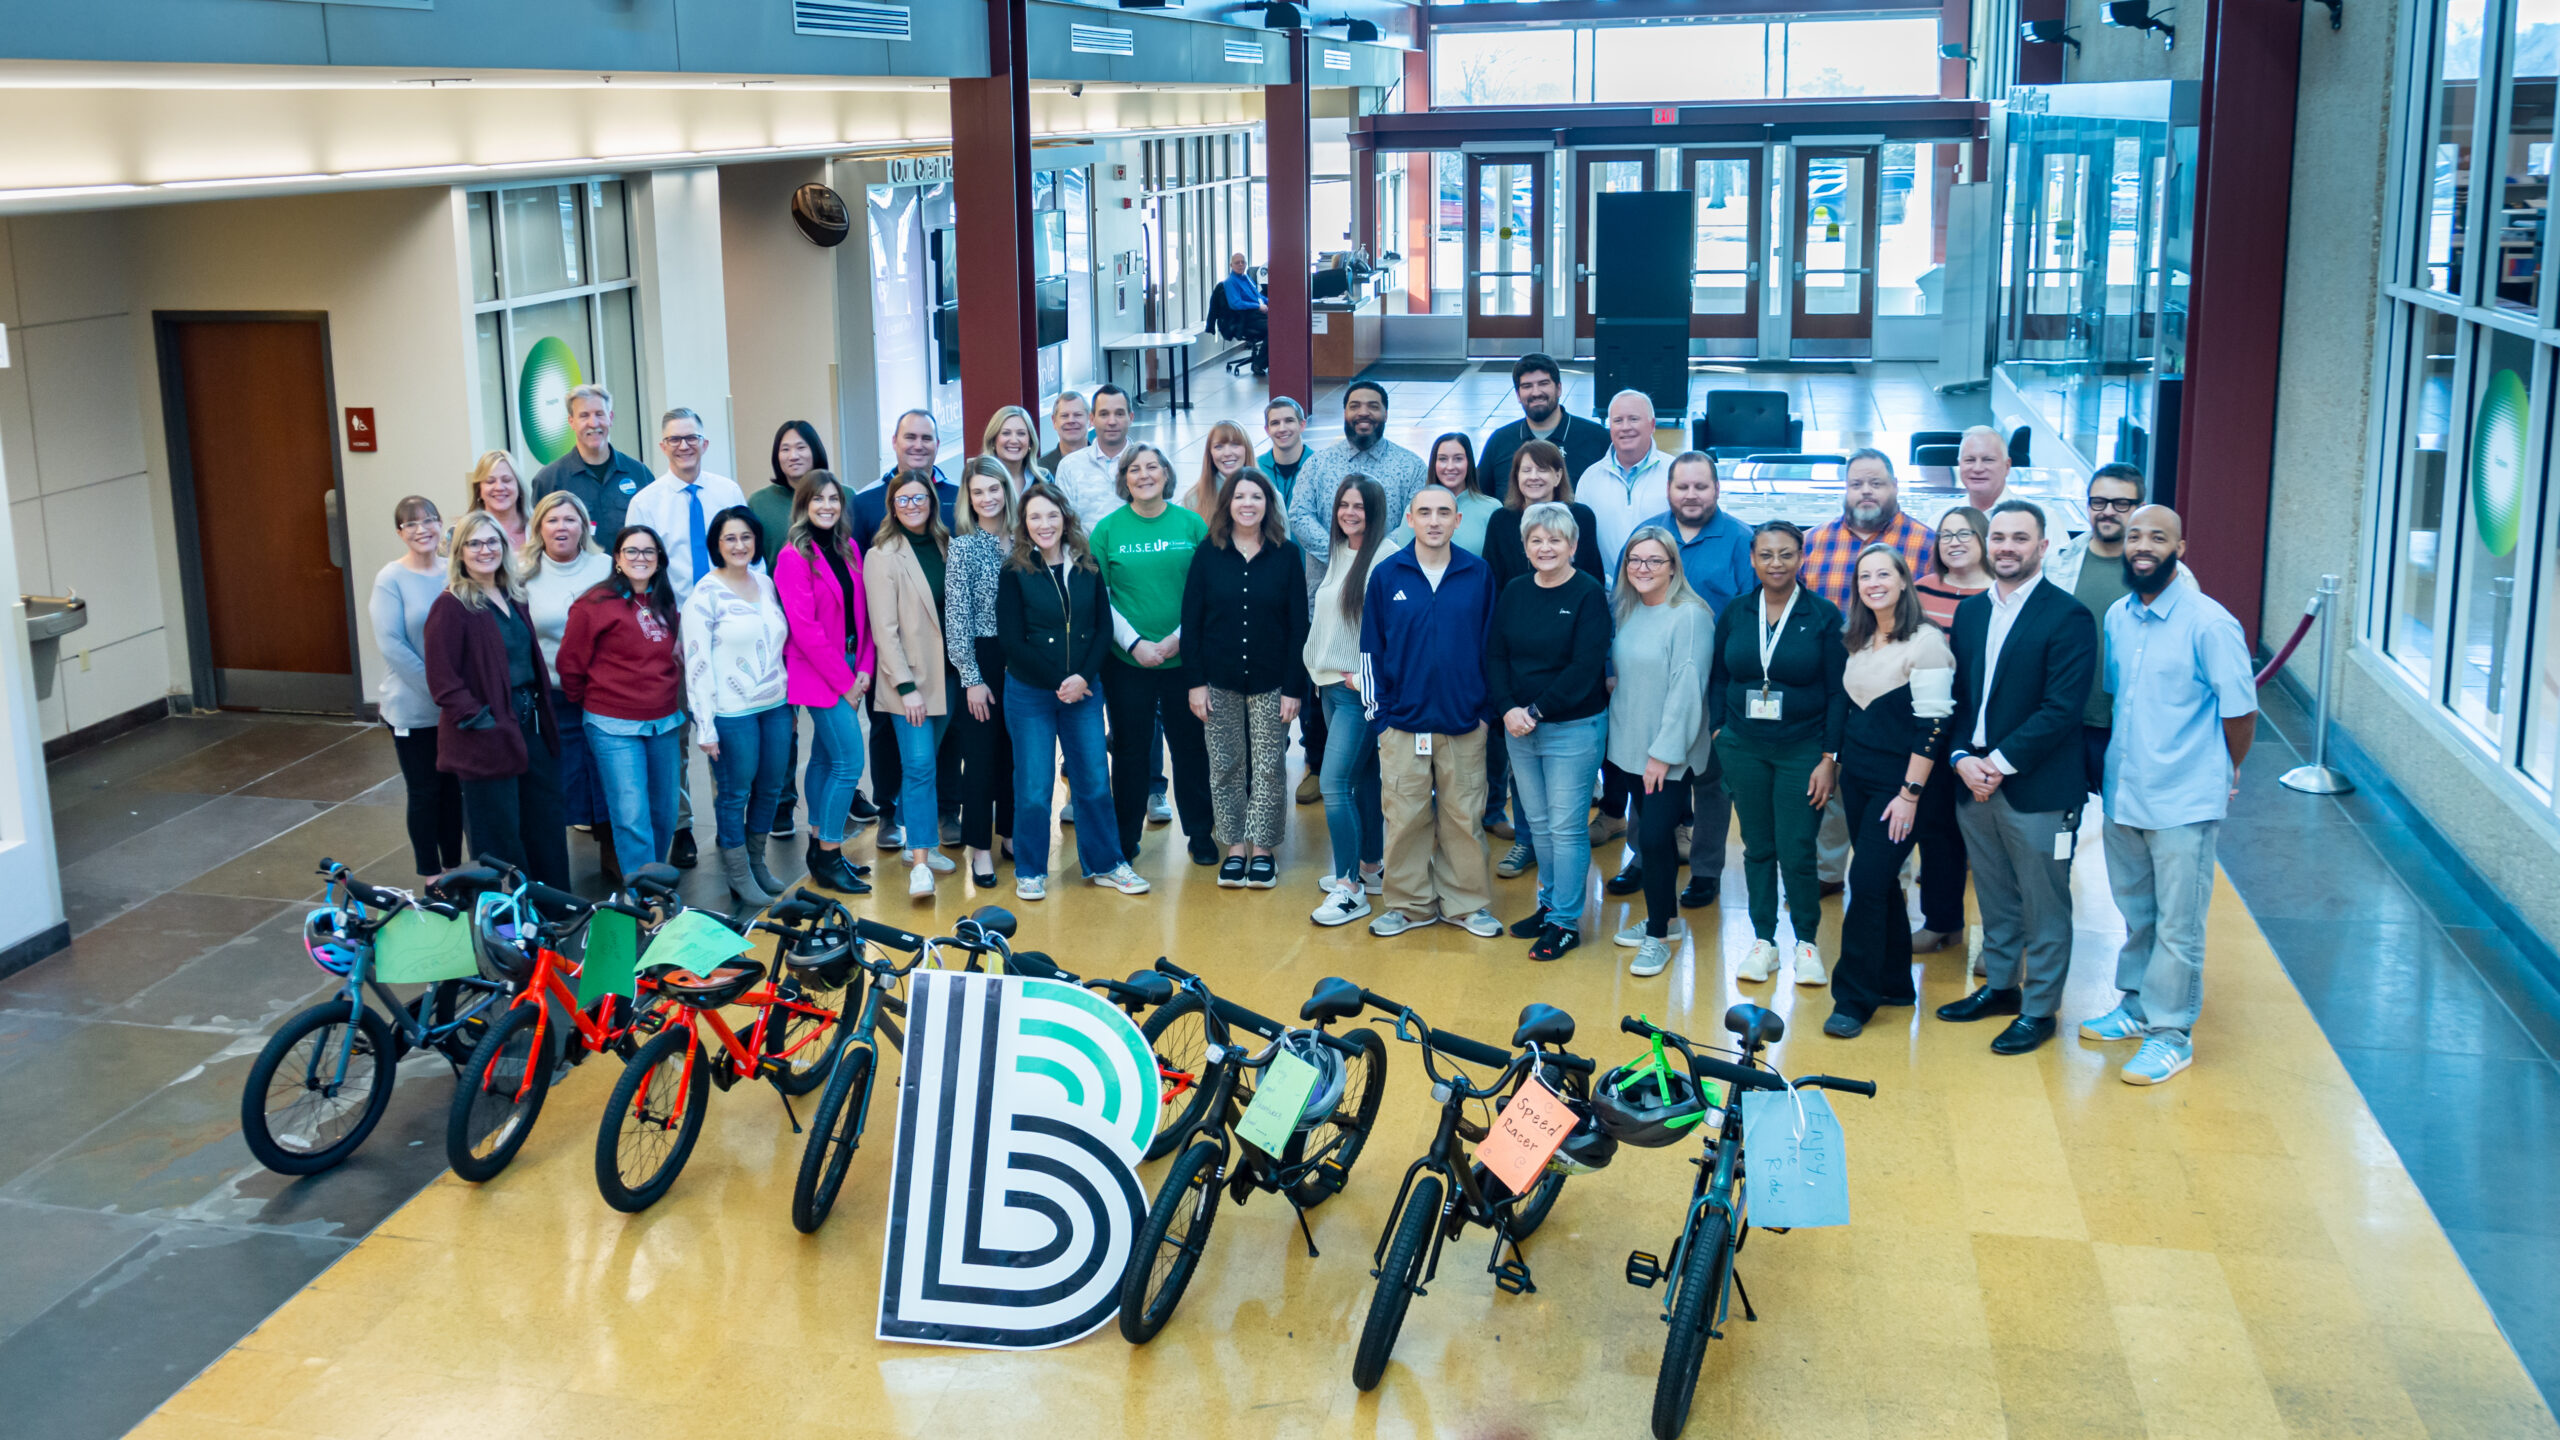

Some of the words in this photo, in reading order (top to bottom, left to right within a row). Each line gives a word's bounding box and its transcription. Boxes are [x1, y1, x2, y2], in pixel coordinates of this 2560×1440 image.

[1654, 108, 1676, 123] EXIT
[891, 160, 911, 183] Our
[1502, 1117, 1538, 1151] Racer
[1517, 1097, 1562, 1137] Speed
[1800, 1111, 1830, 1176] Enjoy
[1763, 1157, 1787, 1204] Ride!
